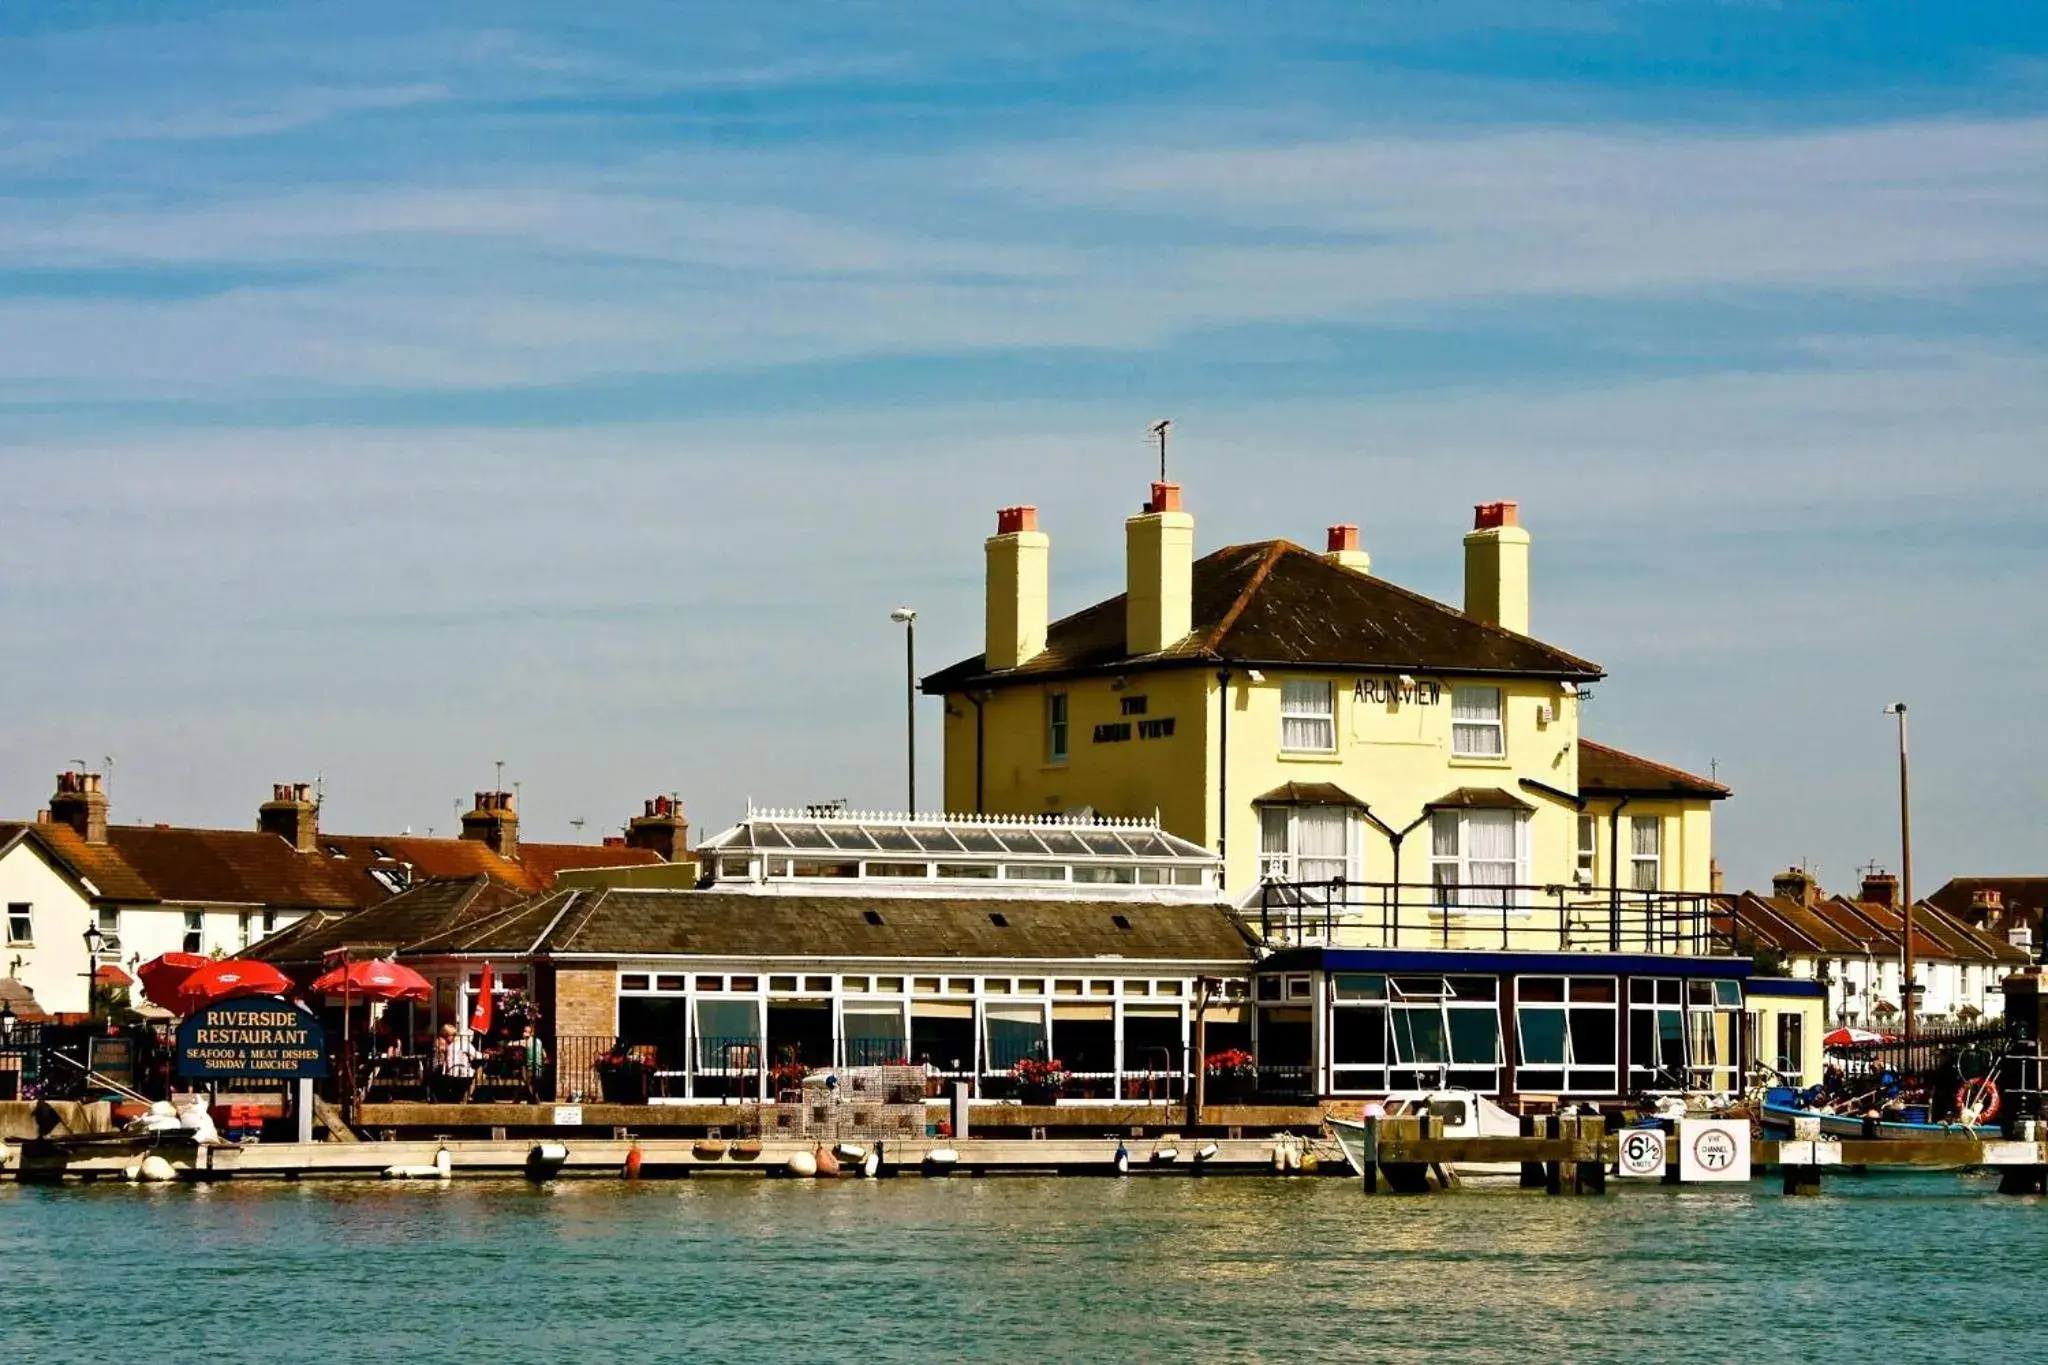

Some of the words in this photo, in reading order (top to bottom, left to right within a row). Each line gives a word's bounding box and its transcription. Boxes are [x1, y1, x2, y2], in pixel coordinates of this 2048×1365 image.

[207, 1011, 297, 1026] RIVERSIDE
[197, 1029, 307, 1044] RESTAURANT
[186, 1048, 235, 1059] SEAFOOD
[238, 1049, 246, 1058] &
[250, 1049, 278, 1059] MEAT
[281, 1049, 319, 1060] DISHES
[205, 1059, 247, 1069] SUNDAY
[250, 1060, 298, 1070] LUNCHES
[1702, 1145, 1729, 1154] CHANNEL
[1708, 1154, 1727, 1167] 71
